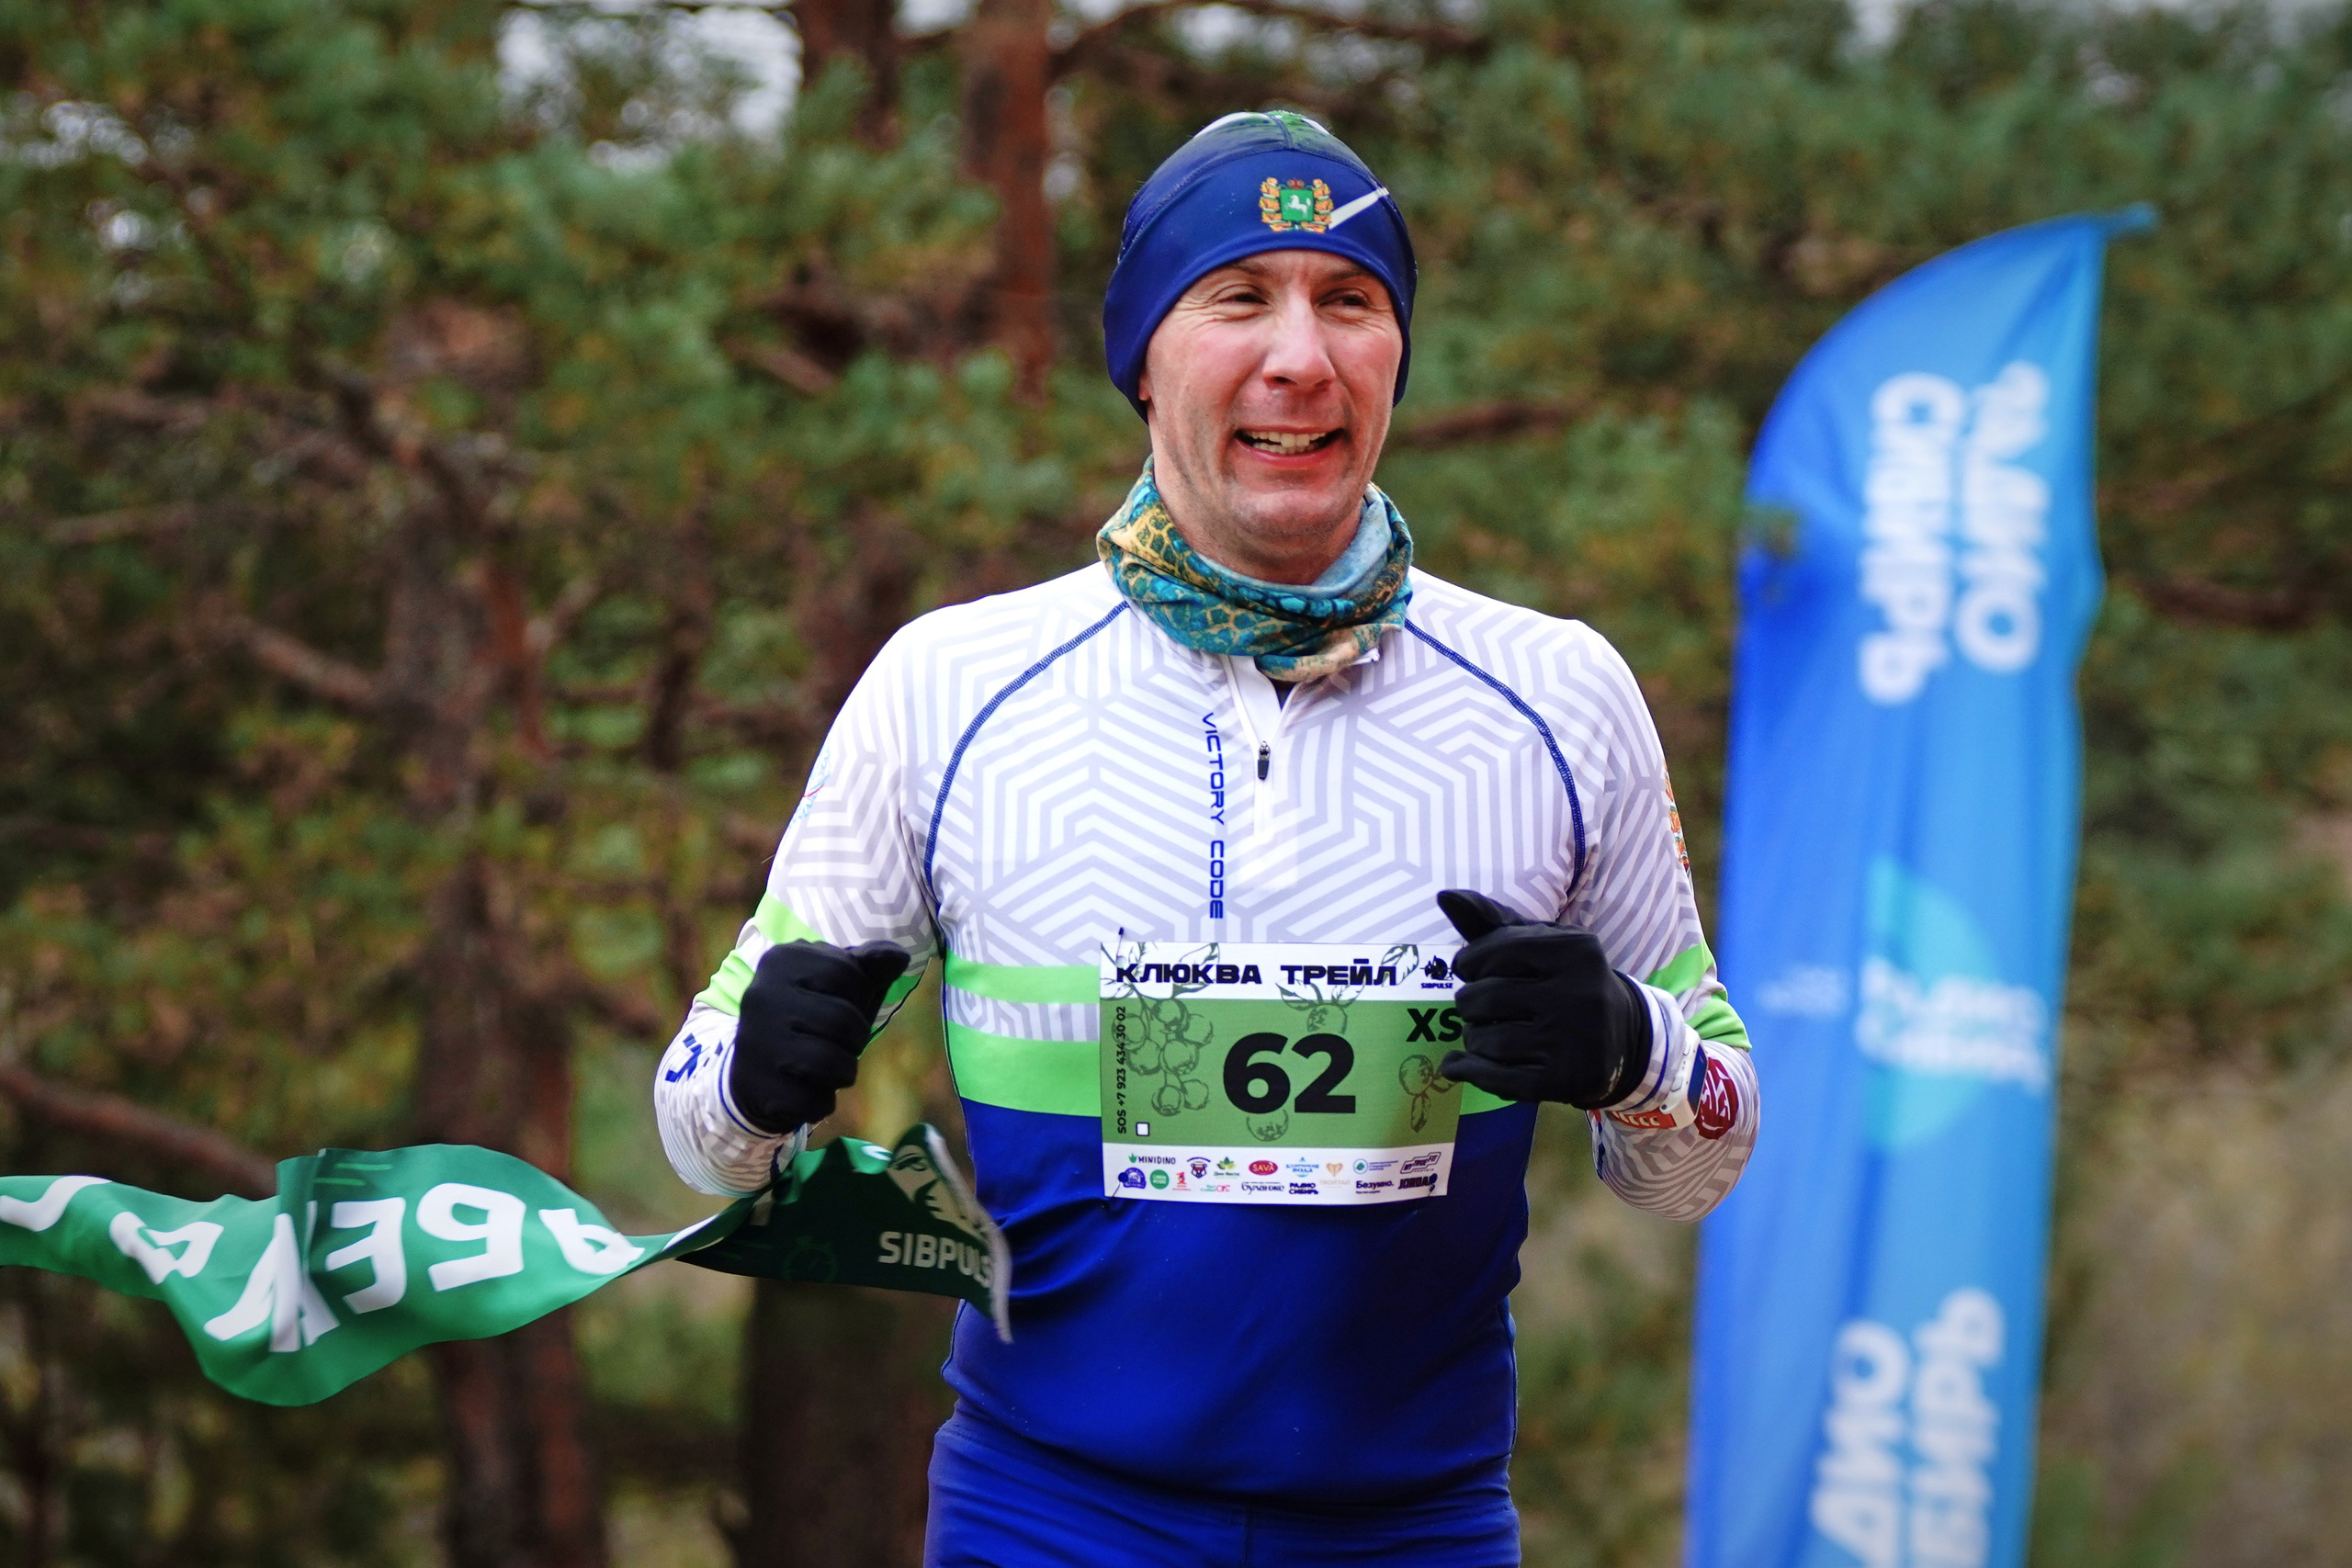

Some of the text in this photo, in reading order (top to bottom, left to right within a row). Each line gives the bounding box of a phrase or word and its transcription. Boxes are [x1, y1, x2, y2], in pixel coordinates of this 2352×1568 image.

[1202, 712, 1225, 919] VICTORY CODE
[1116, 958, 1396, 986] КЛЮКВА ТРЕЙЛ
[1406, 1007, 1464, 1043] XS
[1116, 1006, 1127, 1134] SOS +7 923 434 30 02
[1223, 1032, 1356, 1114] 62
[1137, 1156, 1176, 1165] MINIDINO
[878, 1231, 996, 1290] SIBPULS
